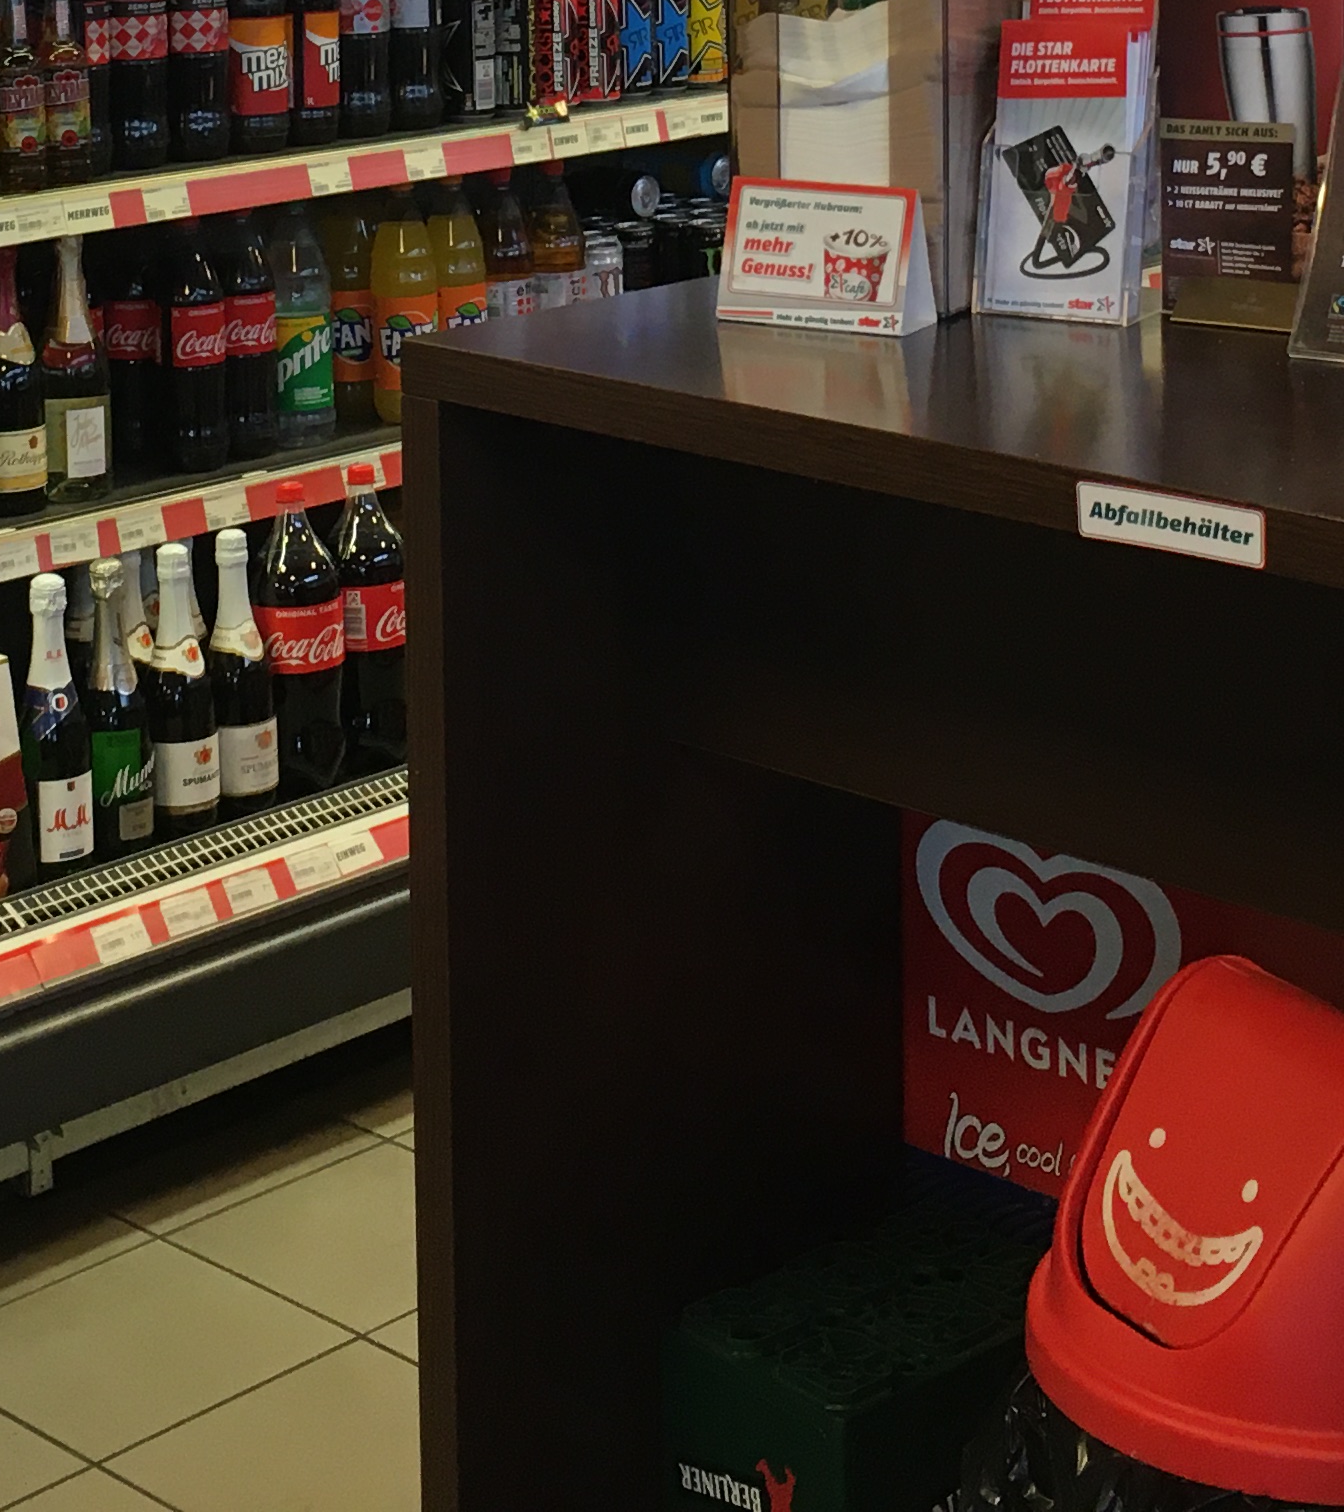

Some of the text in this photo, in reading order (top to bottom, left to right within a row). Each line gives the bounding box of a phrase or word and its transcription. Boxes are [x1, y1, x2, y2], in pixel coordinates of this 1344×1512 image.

[1011, 41, 1073, 57] DIE STAR
[1010, 58, 1116, 74] FLOTTENKARTE
[1167, 124, 1185, 134] DAS
[1225, 127, 1248, 136] SICH
[1253, 128, 1278, 138] AUS:
[1173, 151, 1267, 180] NUR 5,90 €
[749, 196, 863, 215] Vergrößerter Hubraum:
[746, 220, 804, 233] ab jetzt mit
[743, 237, 794, 254] mehr
[741, 258, 814, 280] Genuss!
[1068, 298, 1094, 312] star
[858, 317, 881, 327] star
[277, 326, 332, 393] prite
[1089, 501, 1254, 545] Abfallbehälter
[927, 995, 1117, 1090] LANGNE
[1016, 1142, 1062, 1176] cool
[678, 1462, 762, 1512] BERLINER
